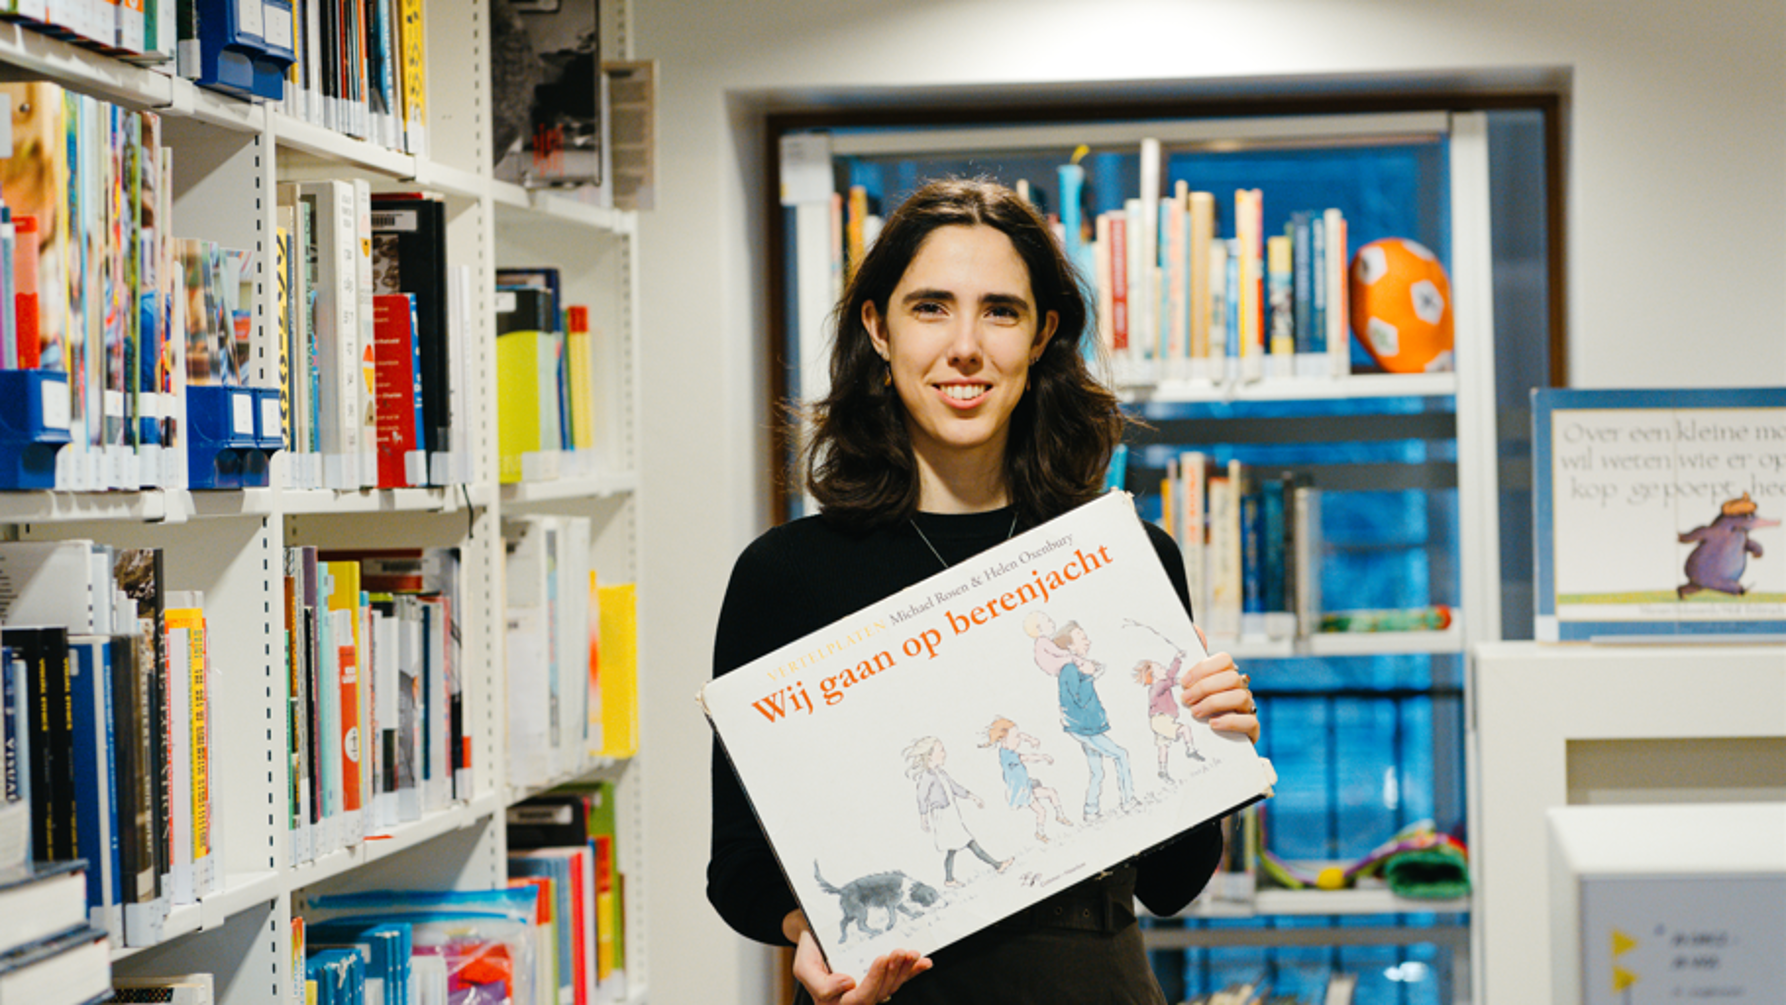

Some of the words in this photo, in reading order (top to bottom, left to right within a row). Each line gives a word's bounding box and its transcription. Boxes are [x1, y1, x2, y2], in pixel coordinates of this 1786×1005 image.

[1563, 422, 1623, 443] Over
[1629, 426, 1672, 442] een
[1676, 420, 1748, 442] kleine
[1561, 446, 1593, 470] wil
[1601, 453, 1671, 470] weten
[1677, 452, 1719, 470] wie
[1726, 452, 1753, 469] er
[1570, 475, 1618, 508] kop
[767, 619, 886, 681] VERTELPLATEN
[889, 596, 935, 626] Michael
[935, 583, 969, 605] Rosen
[970, 575, 983, 588] &
[984, 560, 1019, 581] Helen
[1018, 533, 1074, 564] Oxenbury
[751, 681, 814, 723] Wij
[819, 650, 897, 706] gaan
[902, 628, 942, 660] op
[944, 544, 1114, 636] berenjacht
